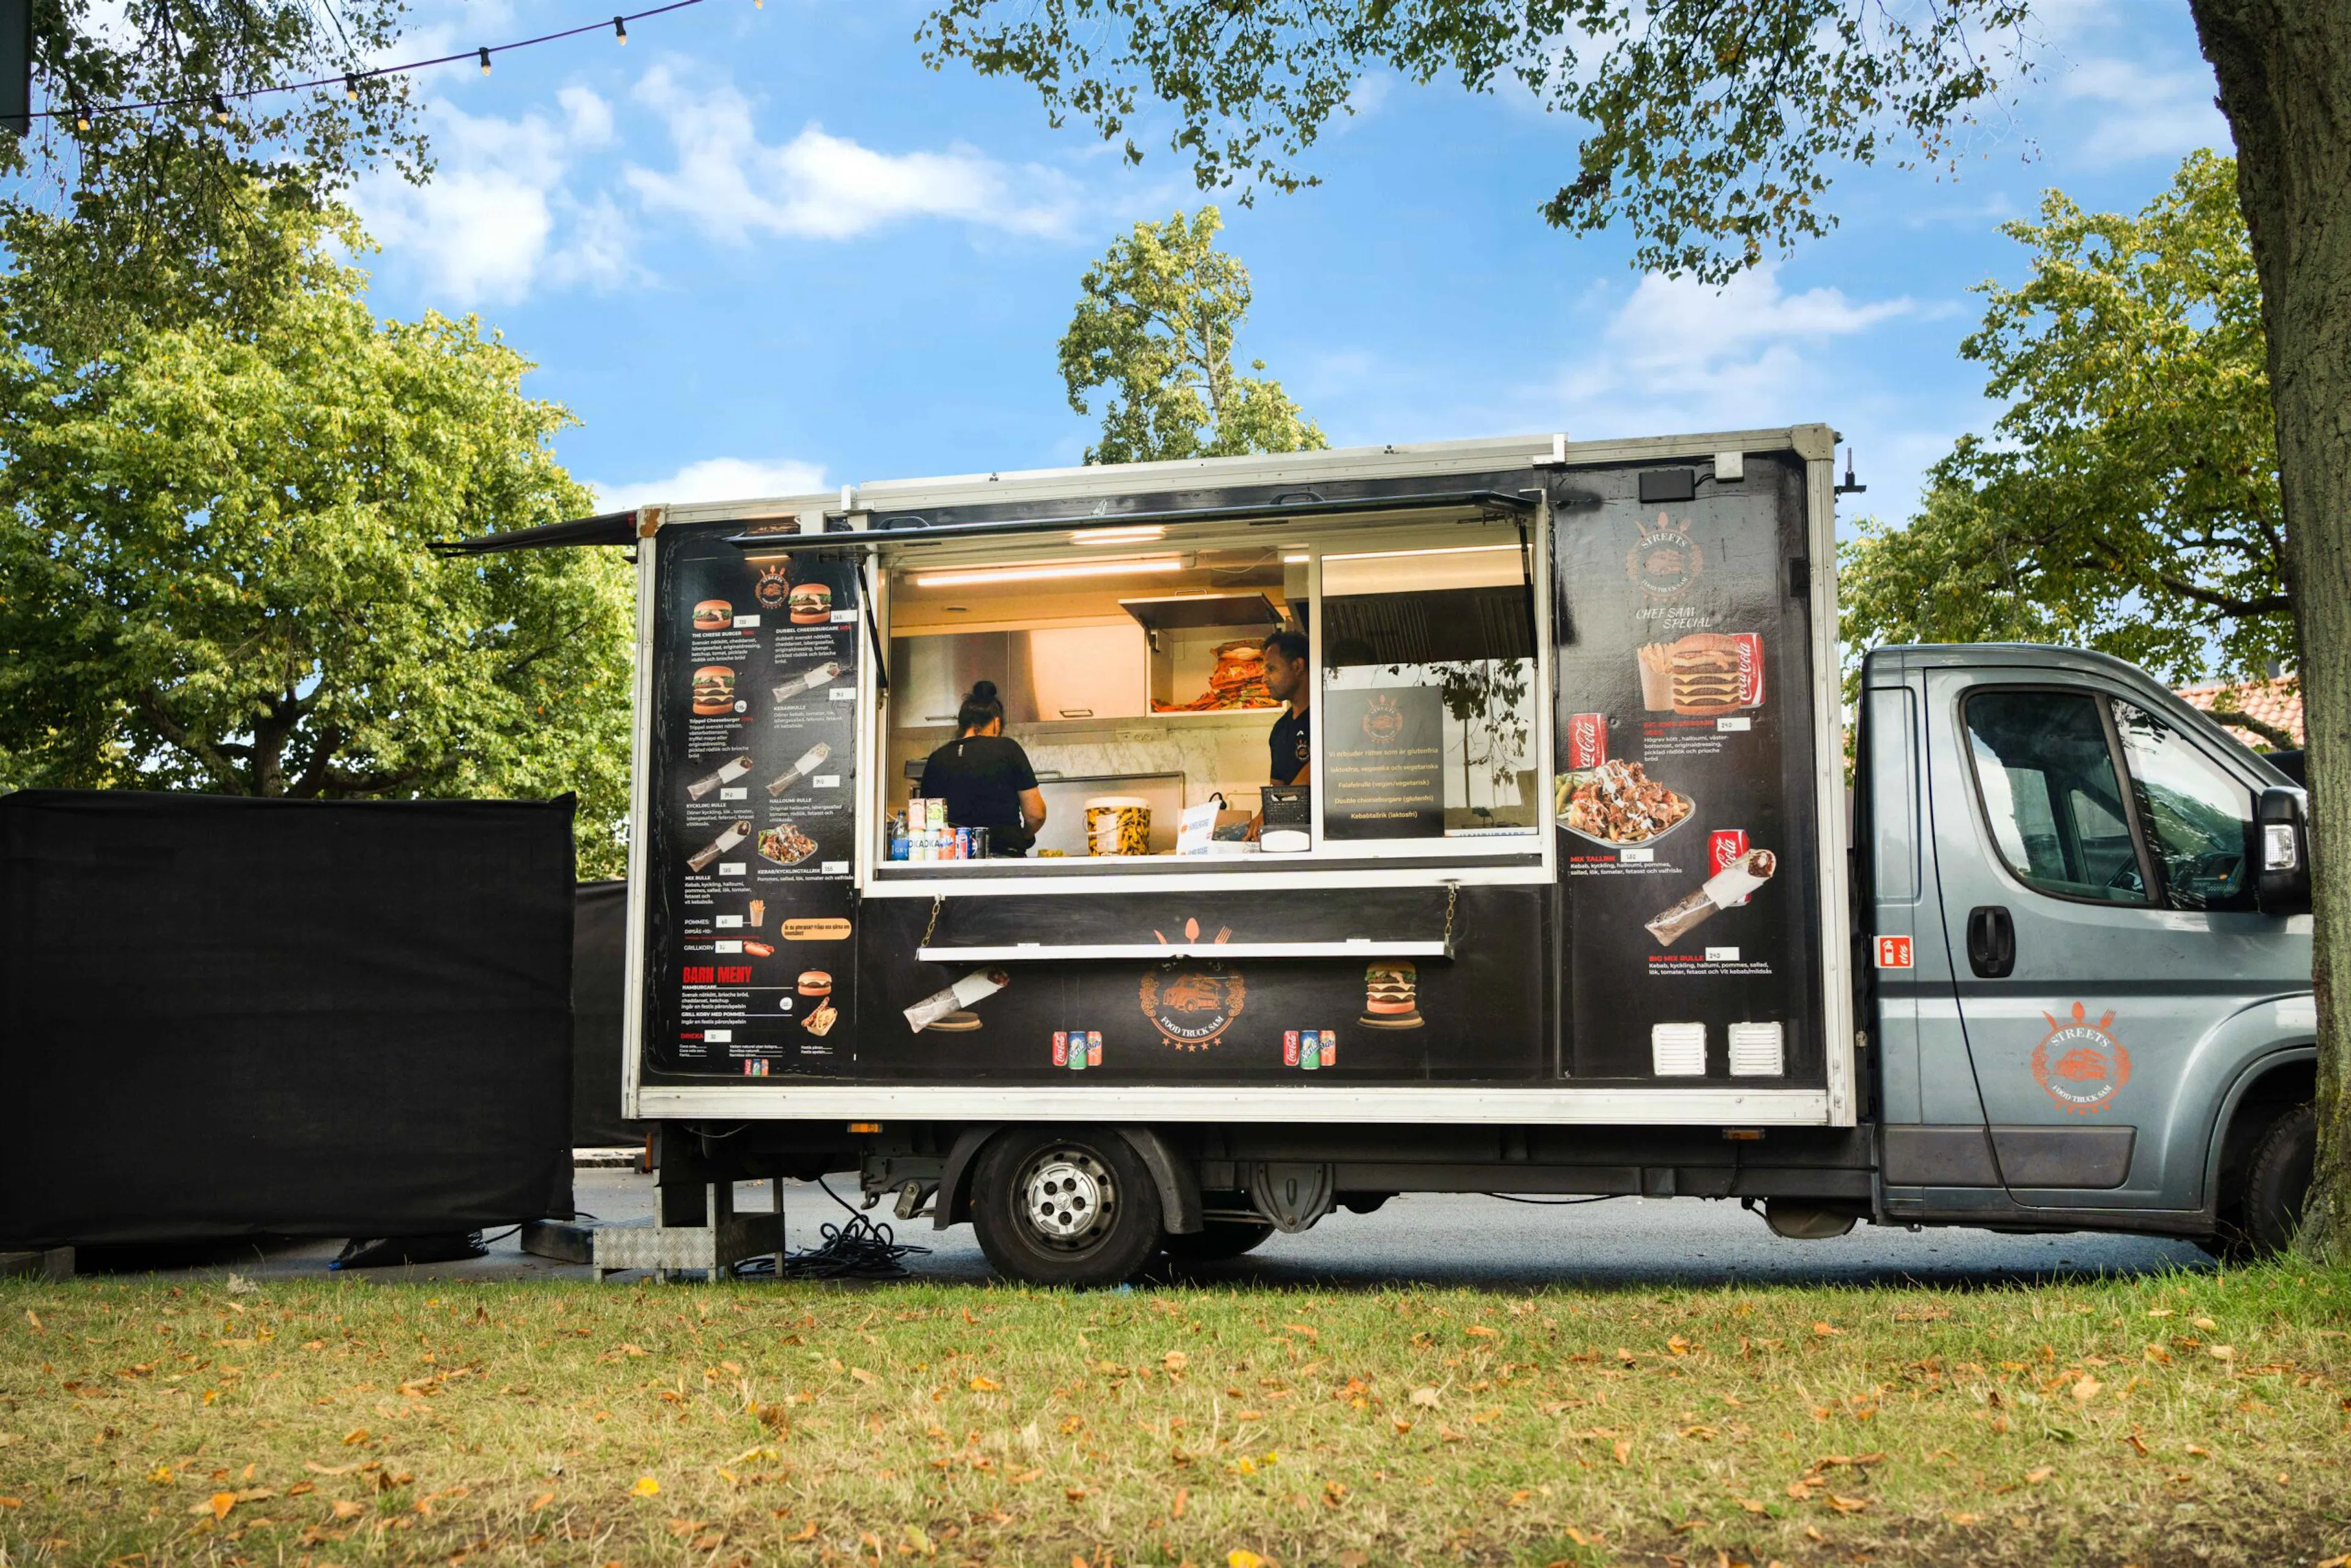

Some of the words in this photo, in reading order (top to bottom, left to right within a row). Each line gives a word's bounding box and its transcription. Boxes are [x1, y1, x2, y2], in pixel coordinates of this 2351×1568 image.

[1641, 533, 1689, 549] STREETS
[1636, 608, 1666, 620] CHEF
[1668, 607, 1695, 618] SAM
[1663, 617, 1712, 629] SPECIAL
[1575, 720, 1595, 767] ca-Cola
[909, 839, 924, 848] OKA
[924, 839, 940, 848] OKA
[683, 966, 714, 983] BARN
[718, 966, 752, 983] MENY
[1161, 1016, 1180, 1033] FOOD
[1182, 1027, 1210, 1037] TRUCK
[1209, 1015, 1224, 1031] SAM
[2051, 1027, 2110, 1048] STREETS
[2053, 1085, 2071, 1100] FOOD
[2072, 1093, 2098, 1103] TRUCK
[2098, 1085, 2112, 1097] SAM
